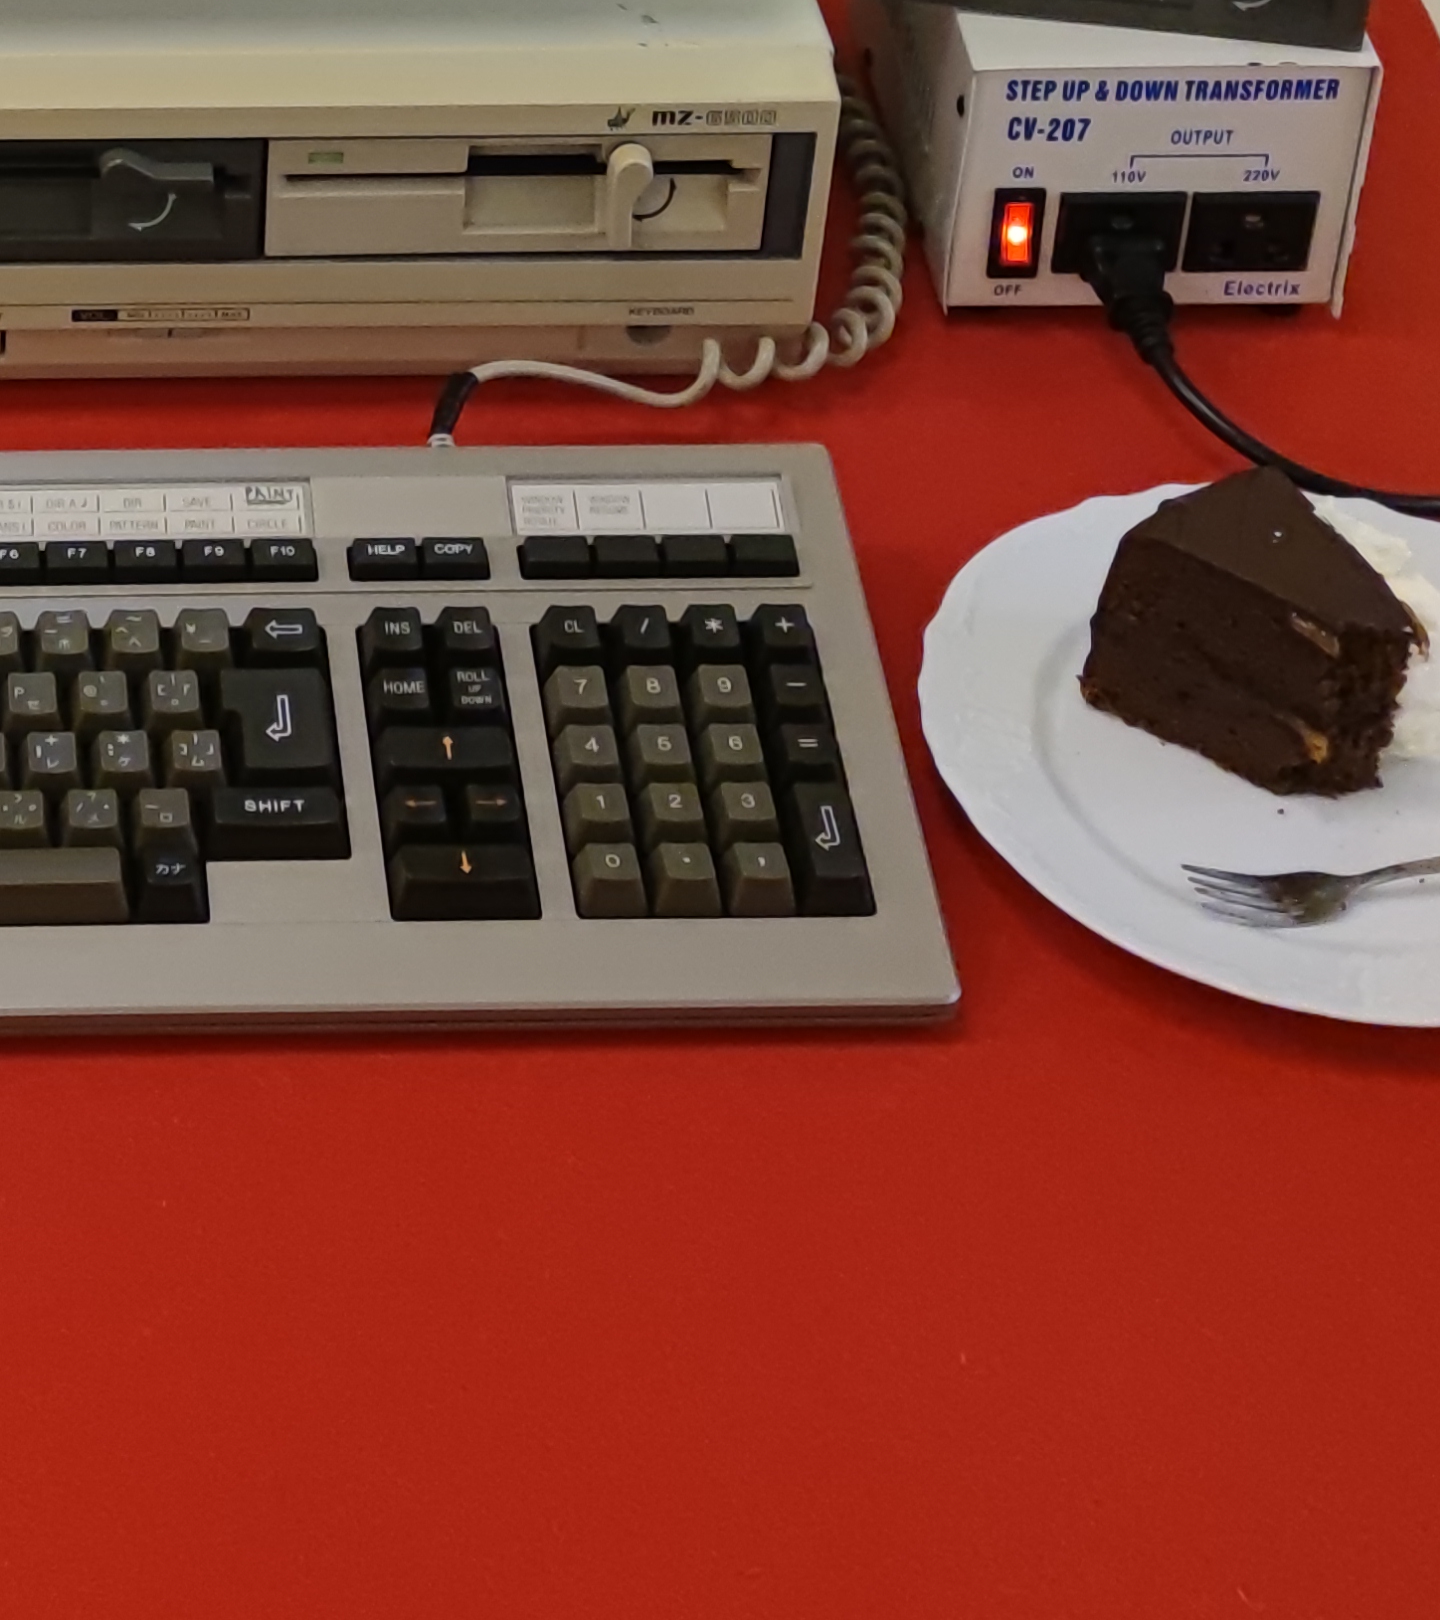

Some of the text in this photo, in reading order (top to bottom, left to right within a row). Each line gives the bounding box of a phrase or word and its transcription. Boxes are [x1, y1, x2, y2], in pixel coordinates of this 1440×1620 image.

[1006, 79, 1340, 102] STEP UP & DOWN TRANSFORMER
[1007, 117, 1091, 142] CV-207
[1170, 130, 1234, 146] OUTPUT
[1012, 166, 1034, 179] ON
[1112, 170, 1147, 183] 110V
[1243, 169, 1281, 183] 220V
[994, 285, 1023, 296] OFF
[1223, 280, 1301, 297] Electrix
[67, 548, 87, 559] F7
[270, 545, 295, 557] F10
[367, 543, 405, 555] HELP
[433, 542, 474, 556] COPY
[385, 620, 410, 636] INS
[453, 619, 483, 635] DEL
[564, 619, 584, 634] CL
[456, 671, 489, 683] ROLL
[383, 679, 424, 695] HOME
[574, 679, 589, 696] 7
[646, 678, 661, 694] 8
[717, 678, 732, 693] 9
[461, 694, 492, 705] DOWN
[585, 737, 599, 753] 4
[657, 736, 672, 752] 5
[729, 736, 743, 751] 6
[244, 798, 305, 812] SHIFT
[596, 795, 606, 810] 1
[669, 794, 683, 809] 2
[741, 793, 755, 809] 3
